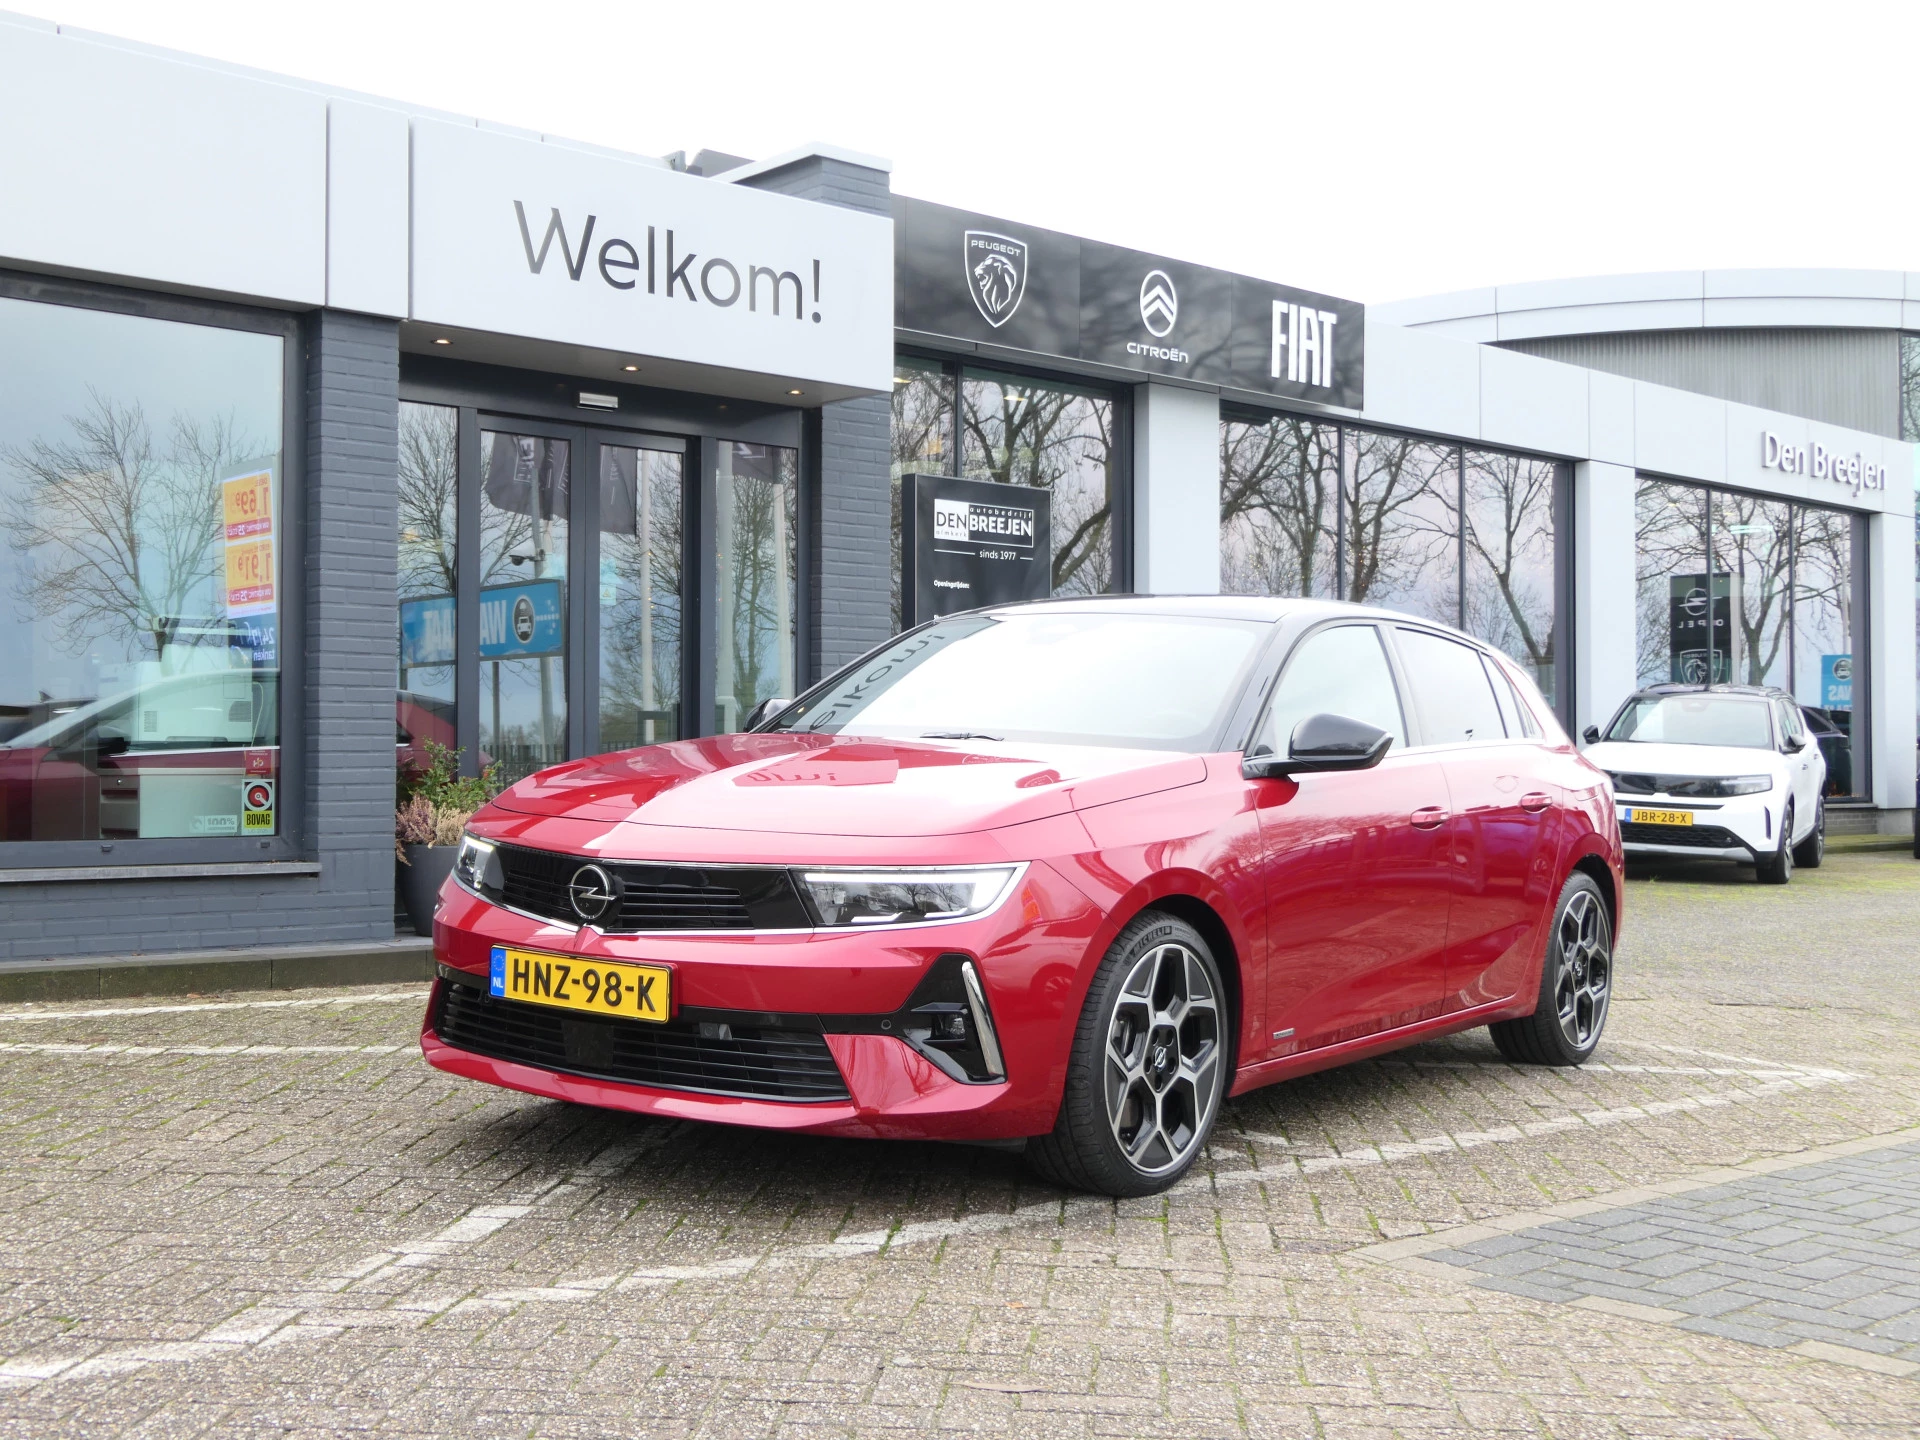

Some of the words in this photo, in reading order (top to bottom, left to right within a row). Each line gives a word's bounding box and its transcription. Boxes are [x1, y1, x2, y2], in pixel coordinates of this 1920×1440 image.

[971, 240, 1021, 257] PEUGEOT
[513, 199, 822, 324] Welkom!
[1271, 299, 1337, 388] FIAT
[1761, 431, 1806, 475] Den
[1810, 441, 1888, 498] Breejen
[969, 507, 1032, 519] autobedrijf
[936, 511, 967, 530] DEN
[969, 514, 1032, 537] BREEJEN
[979, 549, 998, 560] sinds
[1000, 550, 1017, 561] 1977
[246, 813, 271, 826] BOVAG
[1634, 811, 1687, 824] JBR-28-X
[492, 977, 504, 989] NL
[512, 958, 656, 1013] HNZ-98-K
